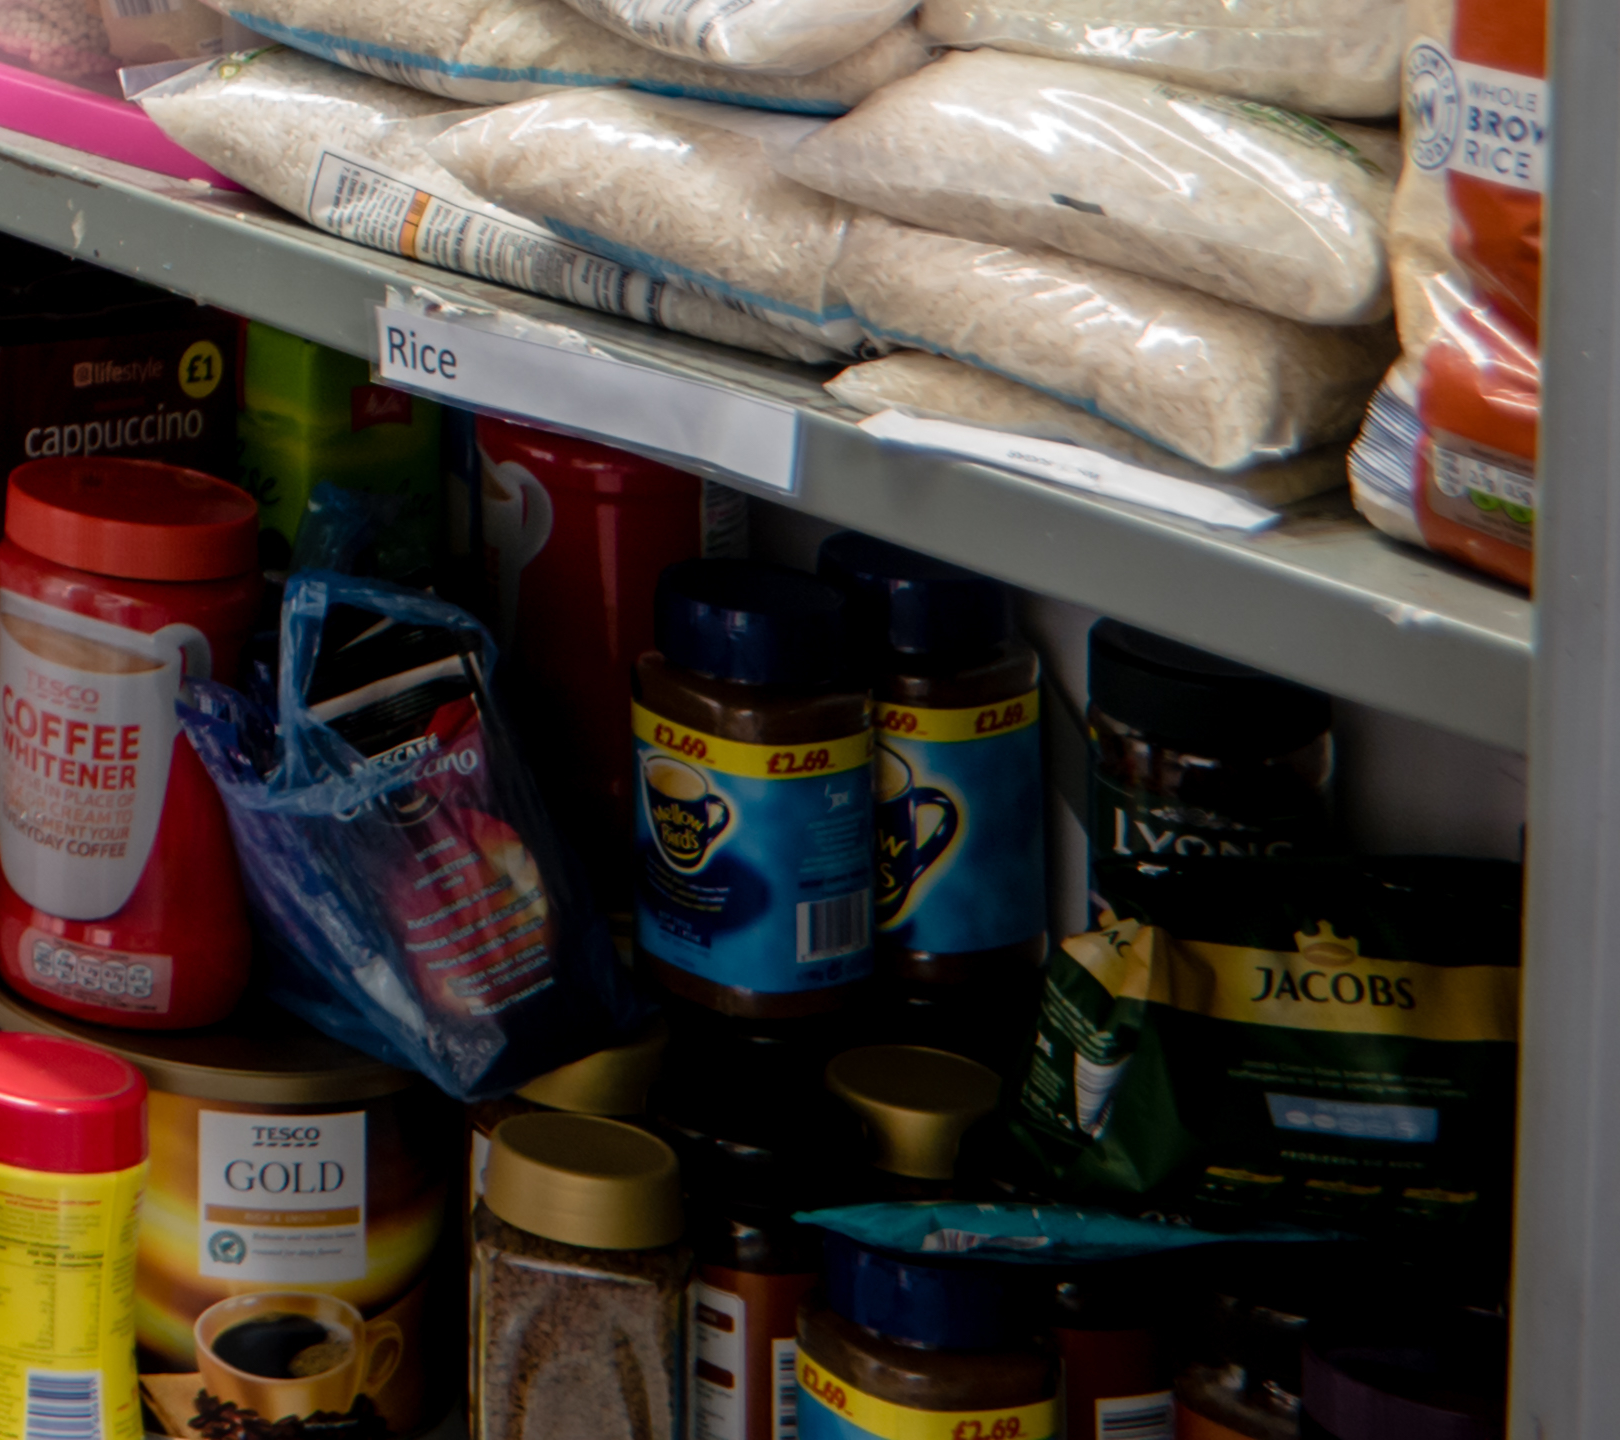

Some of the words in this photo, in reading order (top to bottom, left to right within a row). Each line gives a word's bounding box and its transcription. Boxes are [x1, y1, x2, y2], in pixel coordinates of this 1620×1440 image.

[1467, 79, 1538, 113] WHOLE
[1464, 138, 1531, 178] RICE
[90, 358, 164, 384] lifestyle
[186, 356, 217, 385] £1
[388, 333, 458, 380] Rice
[23, 405, 204, 461] cappuccino
[25, 668, 99, 705] TESCO
[2, 684, 142, 762] COFFEE
[974, 702, 1025, 734] £2.69
[2, 719, 136, 791] WHITENER
[652, 723, 708, 760] £2.69
[766, 748, 831, 774] £2.69
[50, 802, 113, 825] CREAM
[115, 810, 133, 824] TO
[64, 789, 112, 807] PLACE
[117, 793, 135, 807] OF
[91, 826, 130, 840] YOUR
[653, 804, 705, 832] Mellow
[66, 839, 128, 858] COFFEE
[662, 823, 700, 850] Bird's
[1251, 966, 1417, 1010] JACOBS
[252, 1126, 321, 1140] TESCO
[224, 1160, 344, 1194] GOLD
